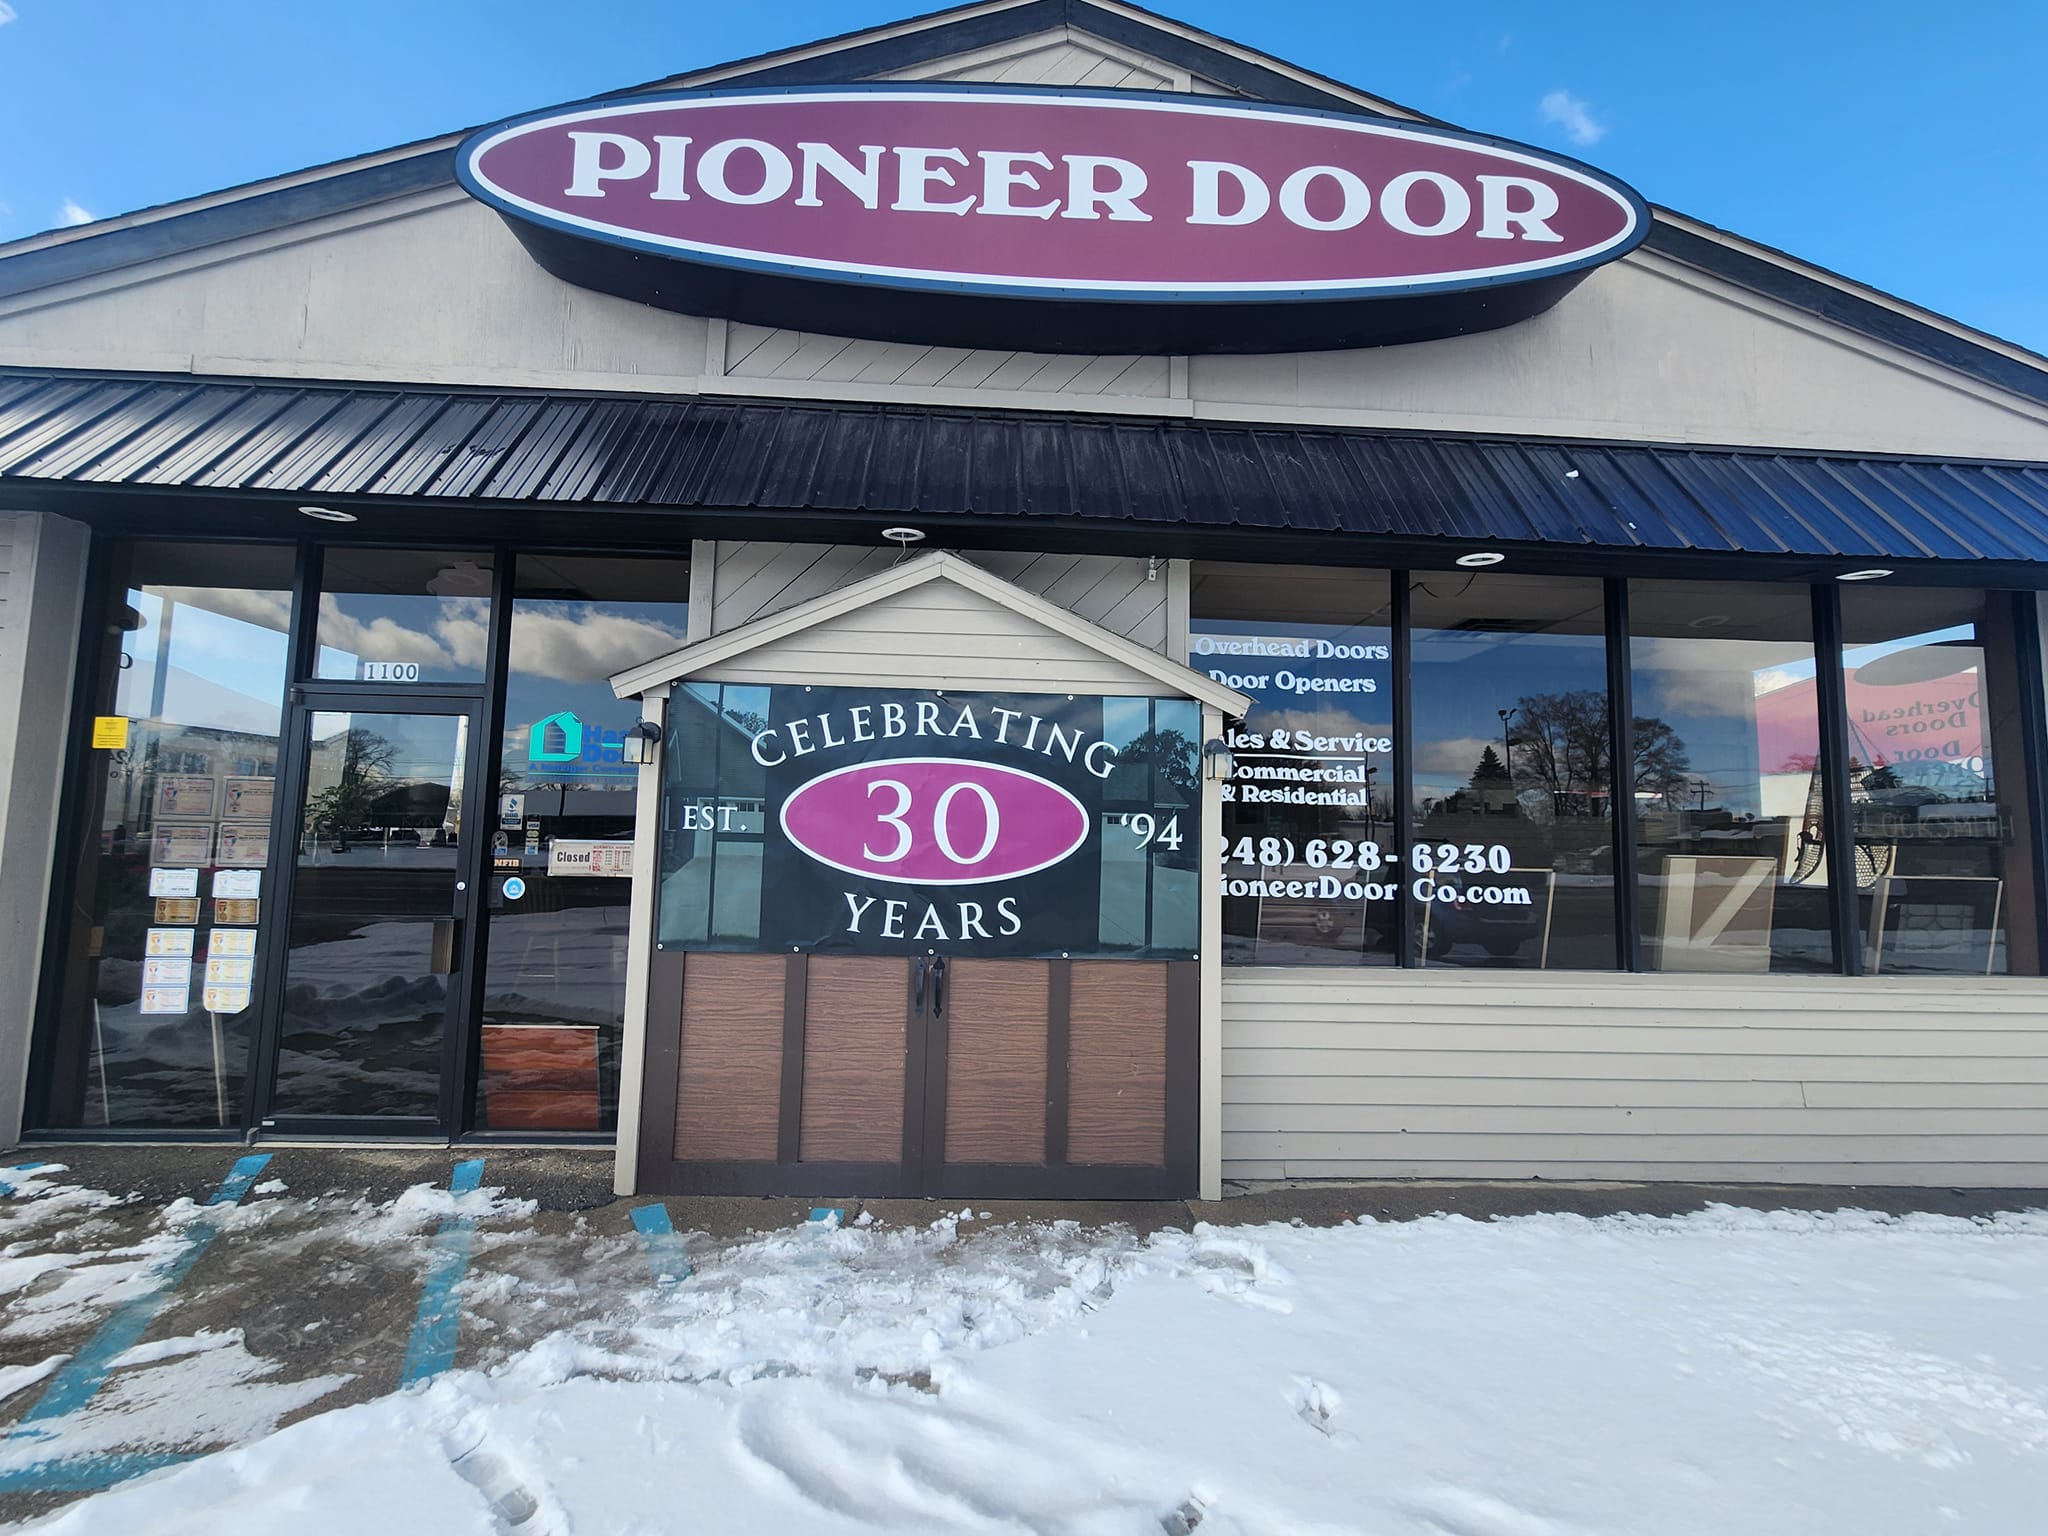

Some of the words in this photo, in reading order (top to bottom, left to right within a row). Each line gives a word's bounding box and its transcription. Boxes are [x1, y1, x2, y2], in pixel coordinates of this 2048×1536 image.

[563, 130, 1153, 223] PIONEER
[1185, 159, 1566, 244] DOOR
[1195, 636, 1311, 660] Overhead
[1315, 638, 1390, 660] Doors
[367, 663, 417, 680] 1100
[1208, 669, 1270, 690] Door
[1274, 670, 1377, 695] Openers
[583, 724, 629, 743] Ha
[751, 701, 1120, 780] CELEBRATING
[1222, 728, 1266, 750] les
[1269, 728, 1291, 751] &
[1294, 729, 1393, 754] Service
[582, 744, 624, 763] Do
[1232, 760, 1367, 784] ommercial
[1222, 783, 1237, 802] &
[1241, 784, 1369, 807] Residential
[682, 804, 748, 832] EST.
[862, 779, 1001, 866] 30
[556, 851, 591, 863] Closed
[1222, 835, 1295, 867] 48)
[1304, 838, 1398, 871] 628-
[1411, 842, 1512, 874] 6230
[1222, 874, 1398, 902] ioneerDoor
[1412, 877, 1532, 905] Co.com
[843, 891, 1022, 941] YEARS
